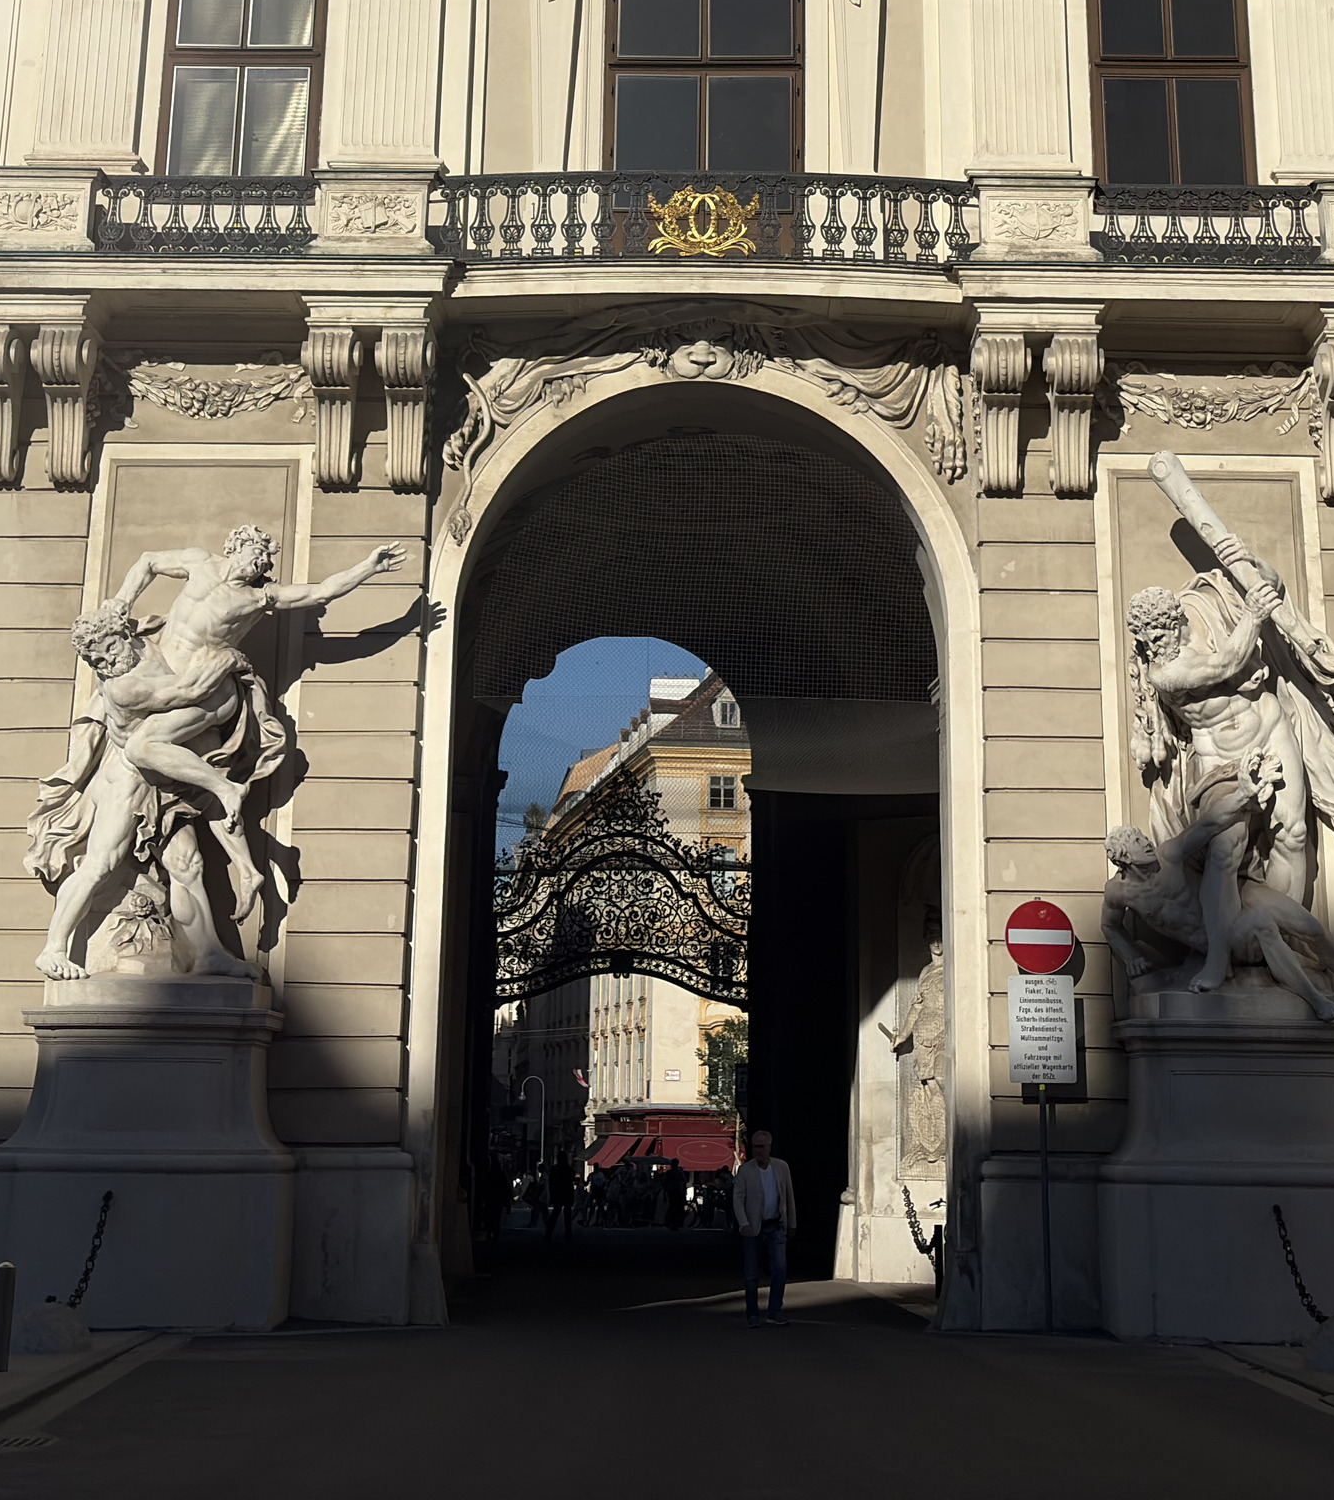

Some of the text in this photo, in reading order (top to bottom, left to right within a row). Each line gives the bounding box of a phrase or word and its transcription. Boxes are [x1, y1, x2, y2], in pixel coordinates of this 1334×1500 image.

[1025, 987, 1044, 995] Fiaker,
[1019, 997, 1063, 1005] Linienomnibusse,
[1019, 1006, 1033, 1014] Fzge.
[1024, 1053, 1051, 1062] Fahrzeuge
[1042, 1063, 1073, 1071] Wagenkarte
